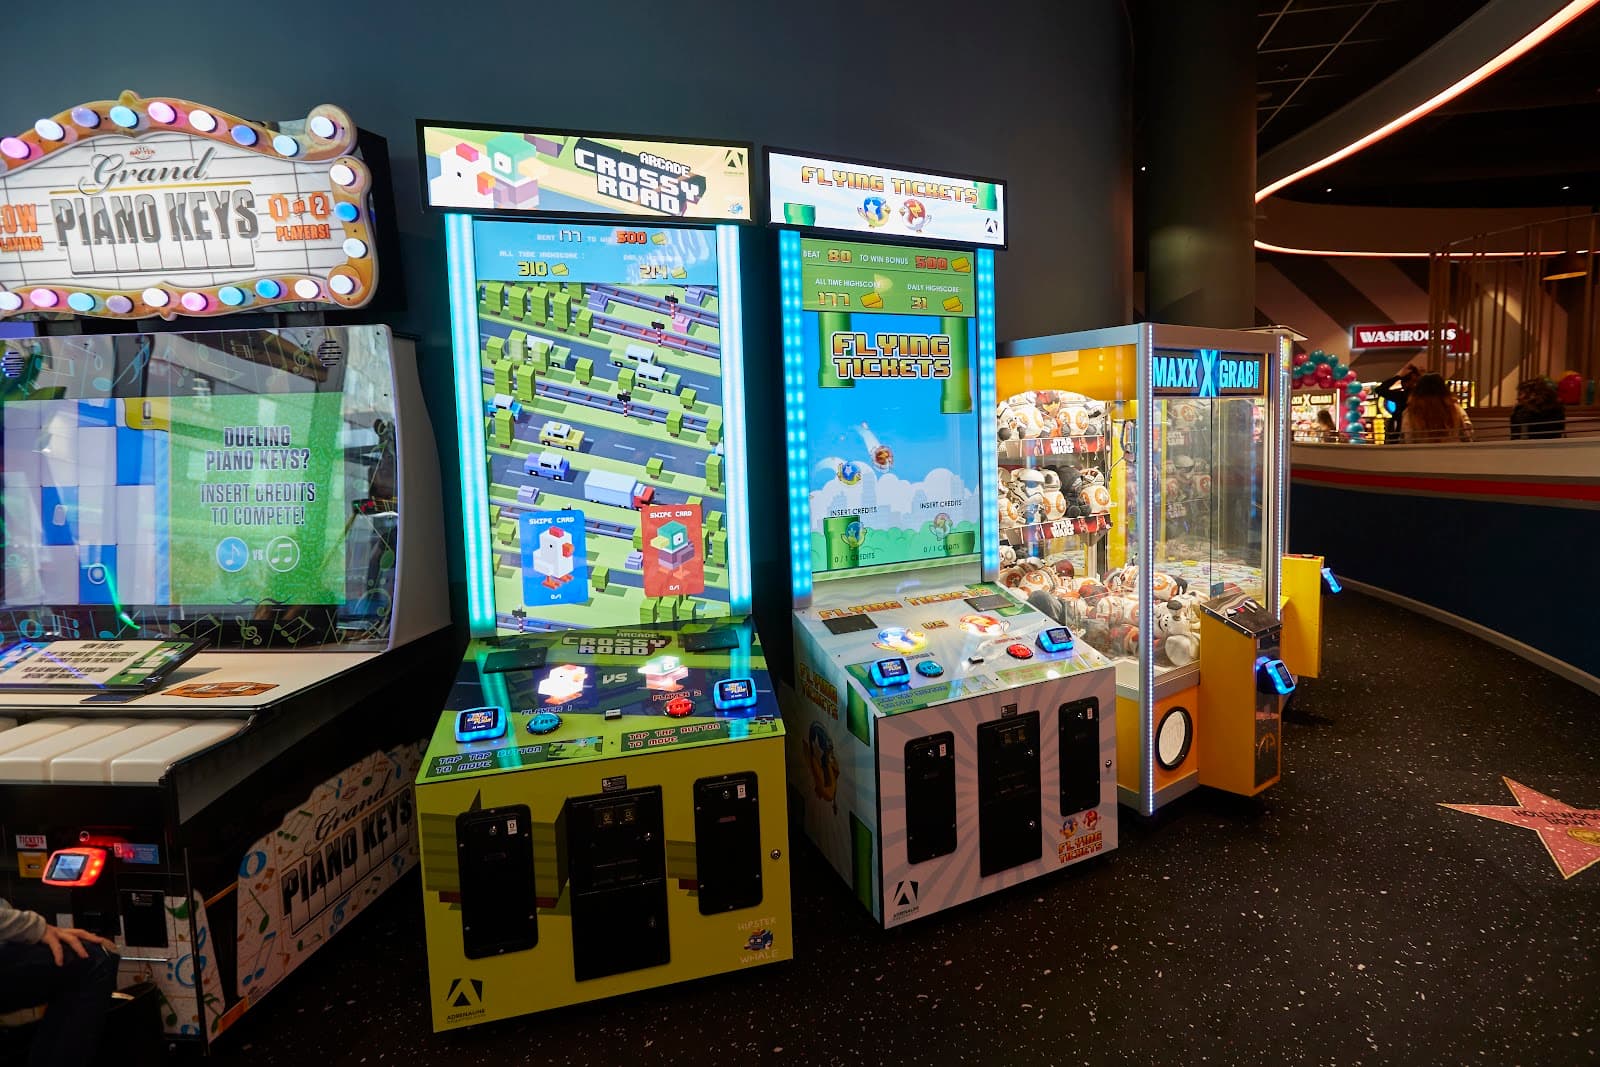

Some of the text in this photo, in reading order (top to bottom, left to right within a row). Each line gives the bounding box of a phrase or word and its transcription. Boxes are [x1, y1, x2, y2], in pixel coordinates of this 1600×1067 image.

[78, 147, 217, 195] Grand
[640, 152, 690, 175] ARCADE
[574, 147, 701, 202] CROSSY
[801, 166, 978, 204] FLYING TICKETS
[597, 173, 683, 216] ROAD
[0, 204, 37, 234] OW
[50, 189, 259, 246] PIANO KEYS
[276, 224, 331, 241] PLAYERS!
[616, 230, 648, 244] 500
[803, 248, 948, 270] BEAT 80 TO WIN BONUS 500
[518, 261, 549, 276] 310
[815, 278, 826, 286] ALL
[827, 279, 843, 287] TIME
[832, 333, 950, 357] FLYING
[834, 358, 952, 378] TICKETS
[1152, 356, 1198, 388] MAXX
[1199, 349, 1218, 397] X
[224, 426, 291, 447] DUELING
[1052, 437, 1072, 446] STAR
[1050, 444, 1075, 455] WARS
[206, 448, 311, 471] PIANO KEYS?
[200, 482, 316, 503] INSERT CREDITS
[852, 506, 878, 515] CREDITS
[920, 499, 962, 509] INSERT CREDITS
[211, 506, 305, 526] TO COMPETE!
[529, 516, 575, 525] SWIPE CARD
[649, 510, 693, 519] SWIPE CARD
[1052, 519, 1072, 528] STAR
[1050, 527, 1075, 538] WARS
[817, 587, 993, 619] FLYING TICKETS
[562, 636, 666, 648] CROSSY
[578, 645, 649, 656] ROAD
[602, 673, 628, 685] VS
[628, 722, 721, 741] TAP TAP BUTTON
[628, 736, 679, 749] TO MOVE
[438, 756, 463, 765] TAP
[469, 751, 493, 761] TAP
[435, 759, 493, 774] TO MOVE
[304, 769, 392, 855] Grand
[18, 835, 44, 845] TICKETS
[281, 787, 412, 915] PIANO KEYS
[737, 917, 777, 931] HIPSTER
[739, 950, 778, 964] WHALE
